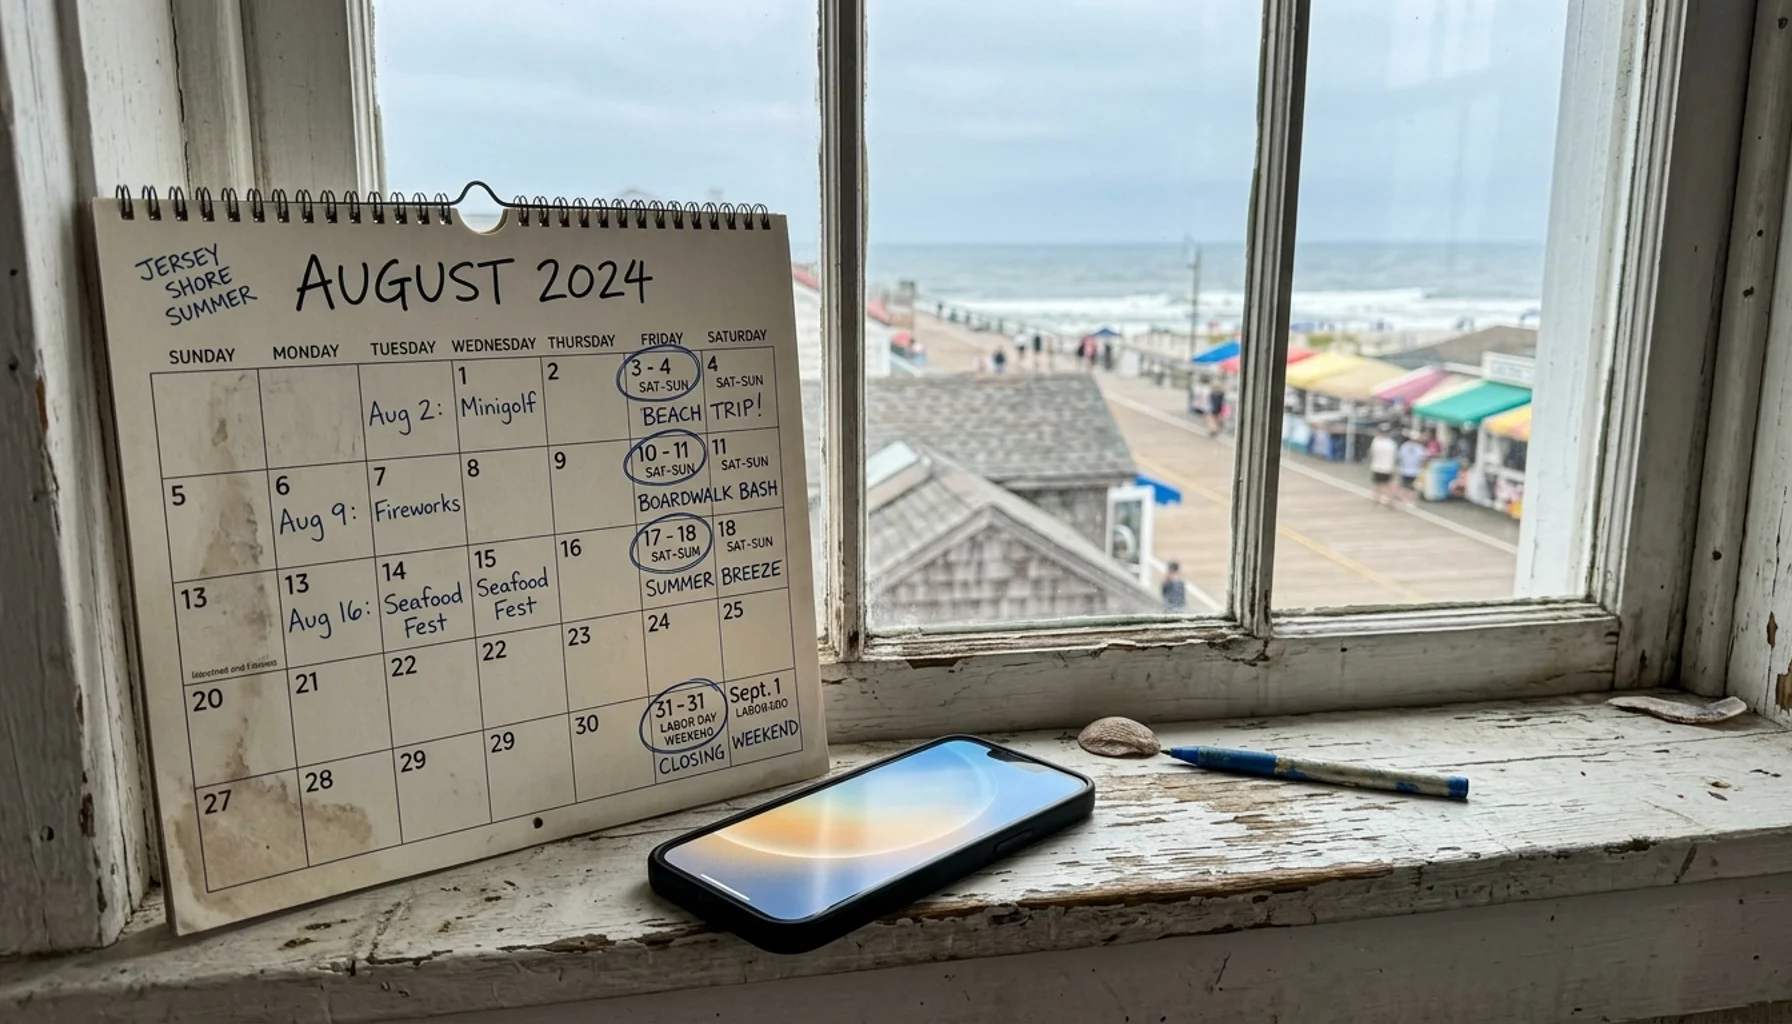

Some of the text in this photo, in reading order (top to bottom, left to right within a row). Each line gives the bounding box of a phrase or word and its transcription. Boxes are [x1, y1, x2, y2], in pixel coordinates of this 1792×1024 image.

[135, 243, 220, 281] JERSEY
[165, 266, 233, 299] SHORE
[296, 254, 653, 312] AUGUST 2024
[165, 285, 258, 326] SUMMER
[452, 337, 536, 353] WEDNESDAY
[548, 334, 616, 349] THURSDAY
[641, 332, 683, 345] FRIDAY
[707, 329, 767, 343] SATURDAY
[169, 348, 235, 365] SUNDAY
[273, 344, 339, 360] MONDAY
[370, 341, 436, 356] TUESDAY
[547, 362, 559, 380] 2
[707, 355, 718, 372] 4
[457, 366, 467, 385] 1
[716, 375, 764, 388] SAT-SUN
[639, 380, 689, 393] SAT-SUN
[369, 390, 537, 436] Aug 2: Minigolf
[641, 392, 762, 426] BEACH TRIP!
[712, 438, 727, 455] 11
[467, 459, 480, 477] 8
[554, 451, 567, 470] 9
[721, 456, 769, 471] SAT-SUN
[275, 475, 290, 495] 6
[373, 466, 386, 486] 7
[171, 485, 186, 506] 5
[637, 479, 778, 512] BOARDWALK BASH
[279, 493, 461, 542] Aug 9: Fireworks
[718, 519, 736, 537] 18
[560, 538, 582, 558] 16
[727, 536, 773, 553] SAT-SUN
[474, 549, 497, 569] 15
[381, 561, 407, 581] 14
[477, 566, 549, 597] Seafood
[646, 560, 782, 597] SUMMER BREEZE
[285, 573, 309, 595] 13
[181, 587, 207, 609] 13
[494, 596, 537, 621] Fest
[288, 581, 463, 639] Aug 16: Seafood
[723, 601, 744, 620] 25
[404, 612, 448, 639] Fest
[648, 613, 670, 633] 24
[567, 626, 591, 647] 23
[482, 640, 507, 661] 22
[391, 655, 417, 677] 22
[295, 671, 319, 694] 21
[730, 677, 780, 703] Sept. 1
[192, 688, 223, 712] 20
[575, 714, 599, 735] 30
[660, 716, 696, 733] LABOR
[490, 731, 515, 753] 29
[659, 719, 799, 775] CLOSING WEEKEND
[400, 750, 426, 773] 29
[305, 769, 333, 793] 28
[203, 789, 232, 815] 27
